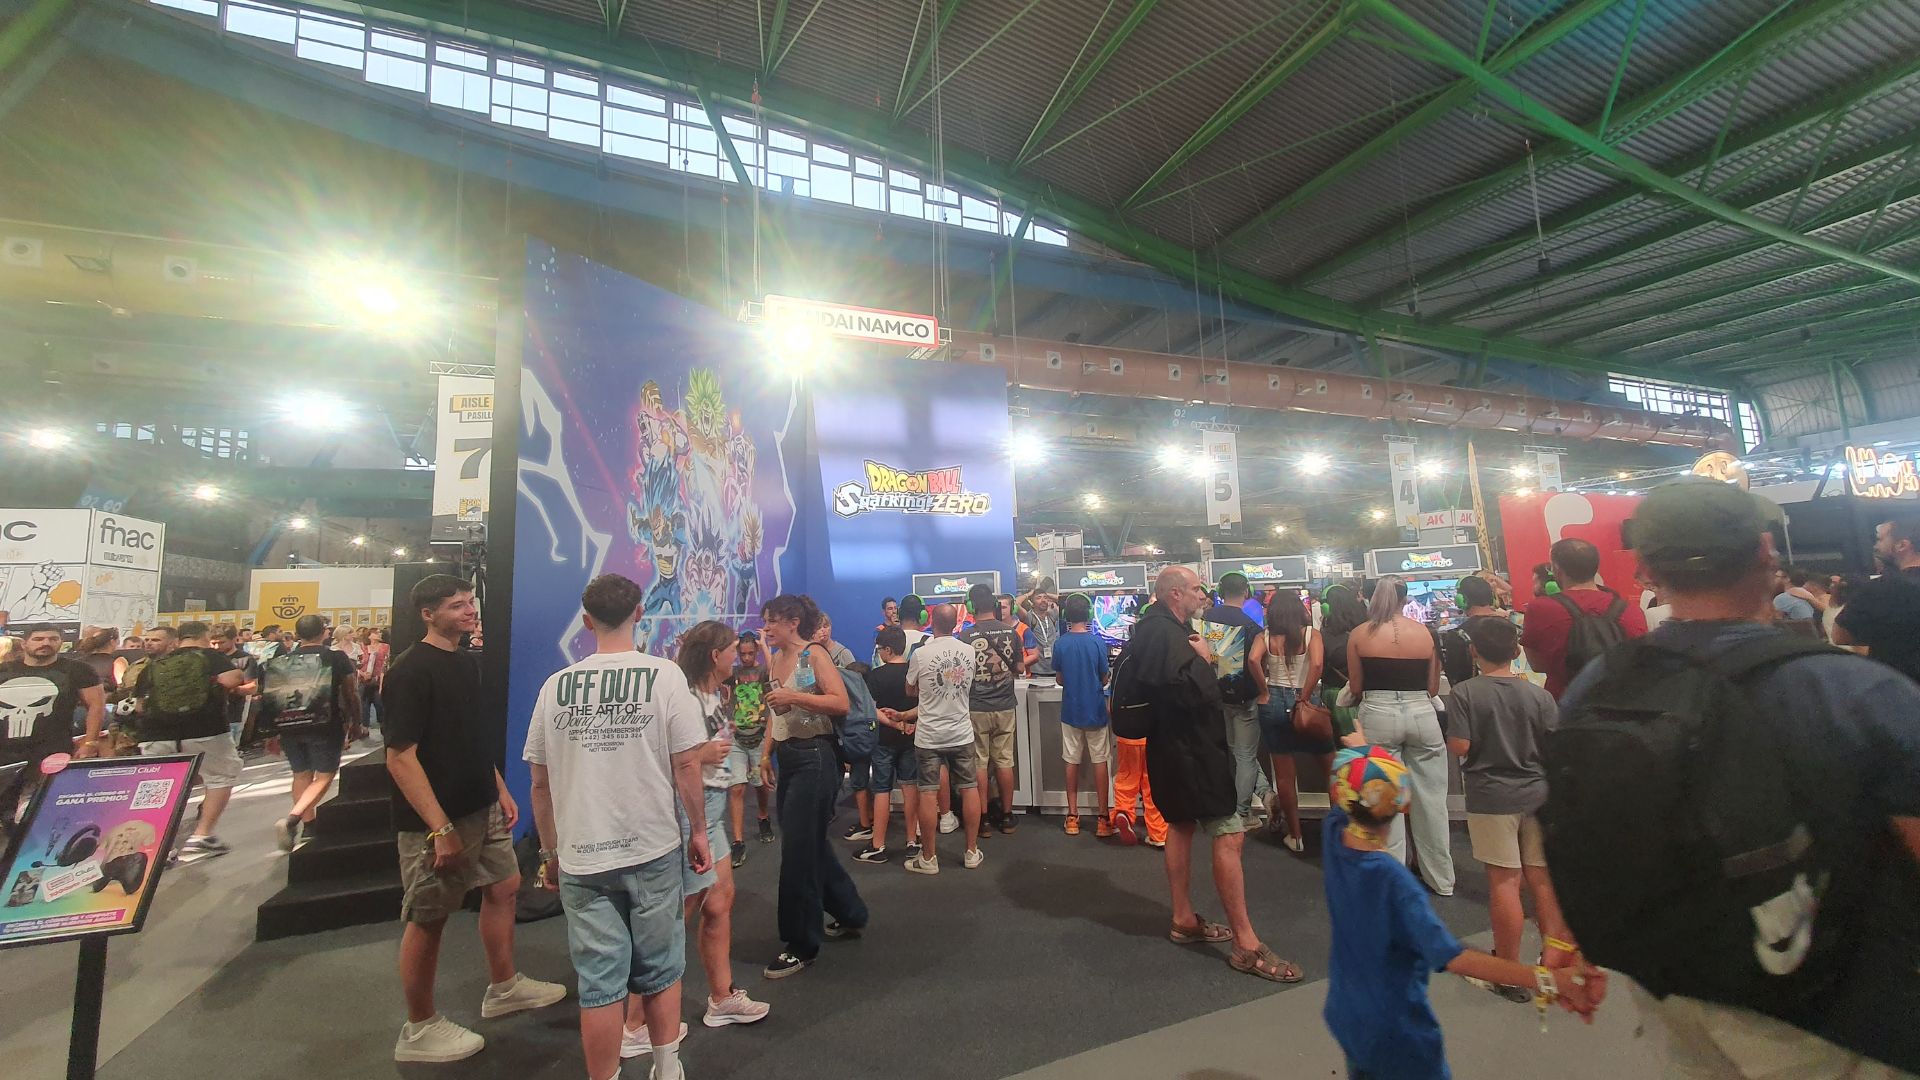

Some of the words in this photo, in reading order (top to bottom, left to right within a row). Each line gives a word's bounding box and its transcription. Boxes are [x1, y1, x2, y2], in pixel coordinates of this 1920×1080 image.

[857, 316, 930, 338] NAMCO
[461, 396, 489, 409] AISLE
[467, 411, 493, 420] PASILL
[454, 437, 492, 480] 7
[866, 461, 928, 494] DRAGON
[928, 467, 961, 494] BALL
[1215, 472, 1233, 501] 5
[1400, 480, 1415, 505] 4
[932, 494, 990, 514] ZERO
[1426, 514, 1445, 526] AK
[1460, 513, 1472, 523] AK
[100, 517, 155, 551] fnac
[942, 649, 952, 658] OF
[556, 669, 599, 707] OFF
[599, 667, 660, 704] DUTY
[568, 704, 593, 717] THE
[595, 703, 623, 717] ART
[624, 703, 643, 714] OF
[553, 711, 597, 734] Doing
[594, 708, 655, 732] Nothing
[137, 766, 161, 774] Club!
[56, 798, 85, 806] GANA
[86, 794, 129, 804] PREMIOS
